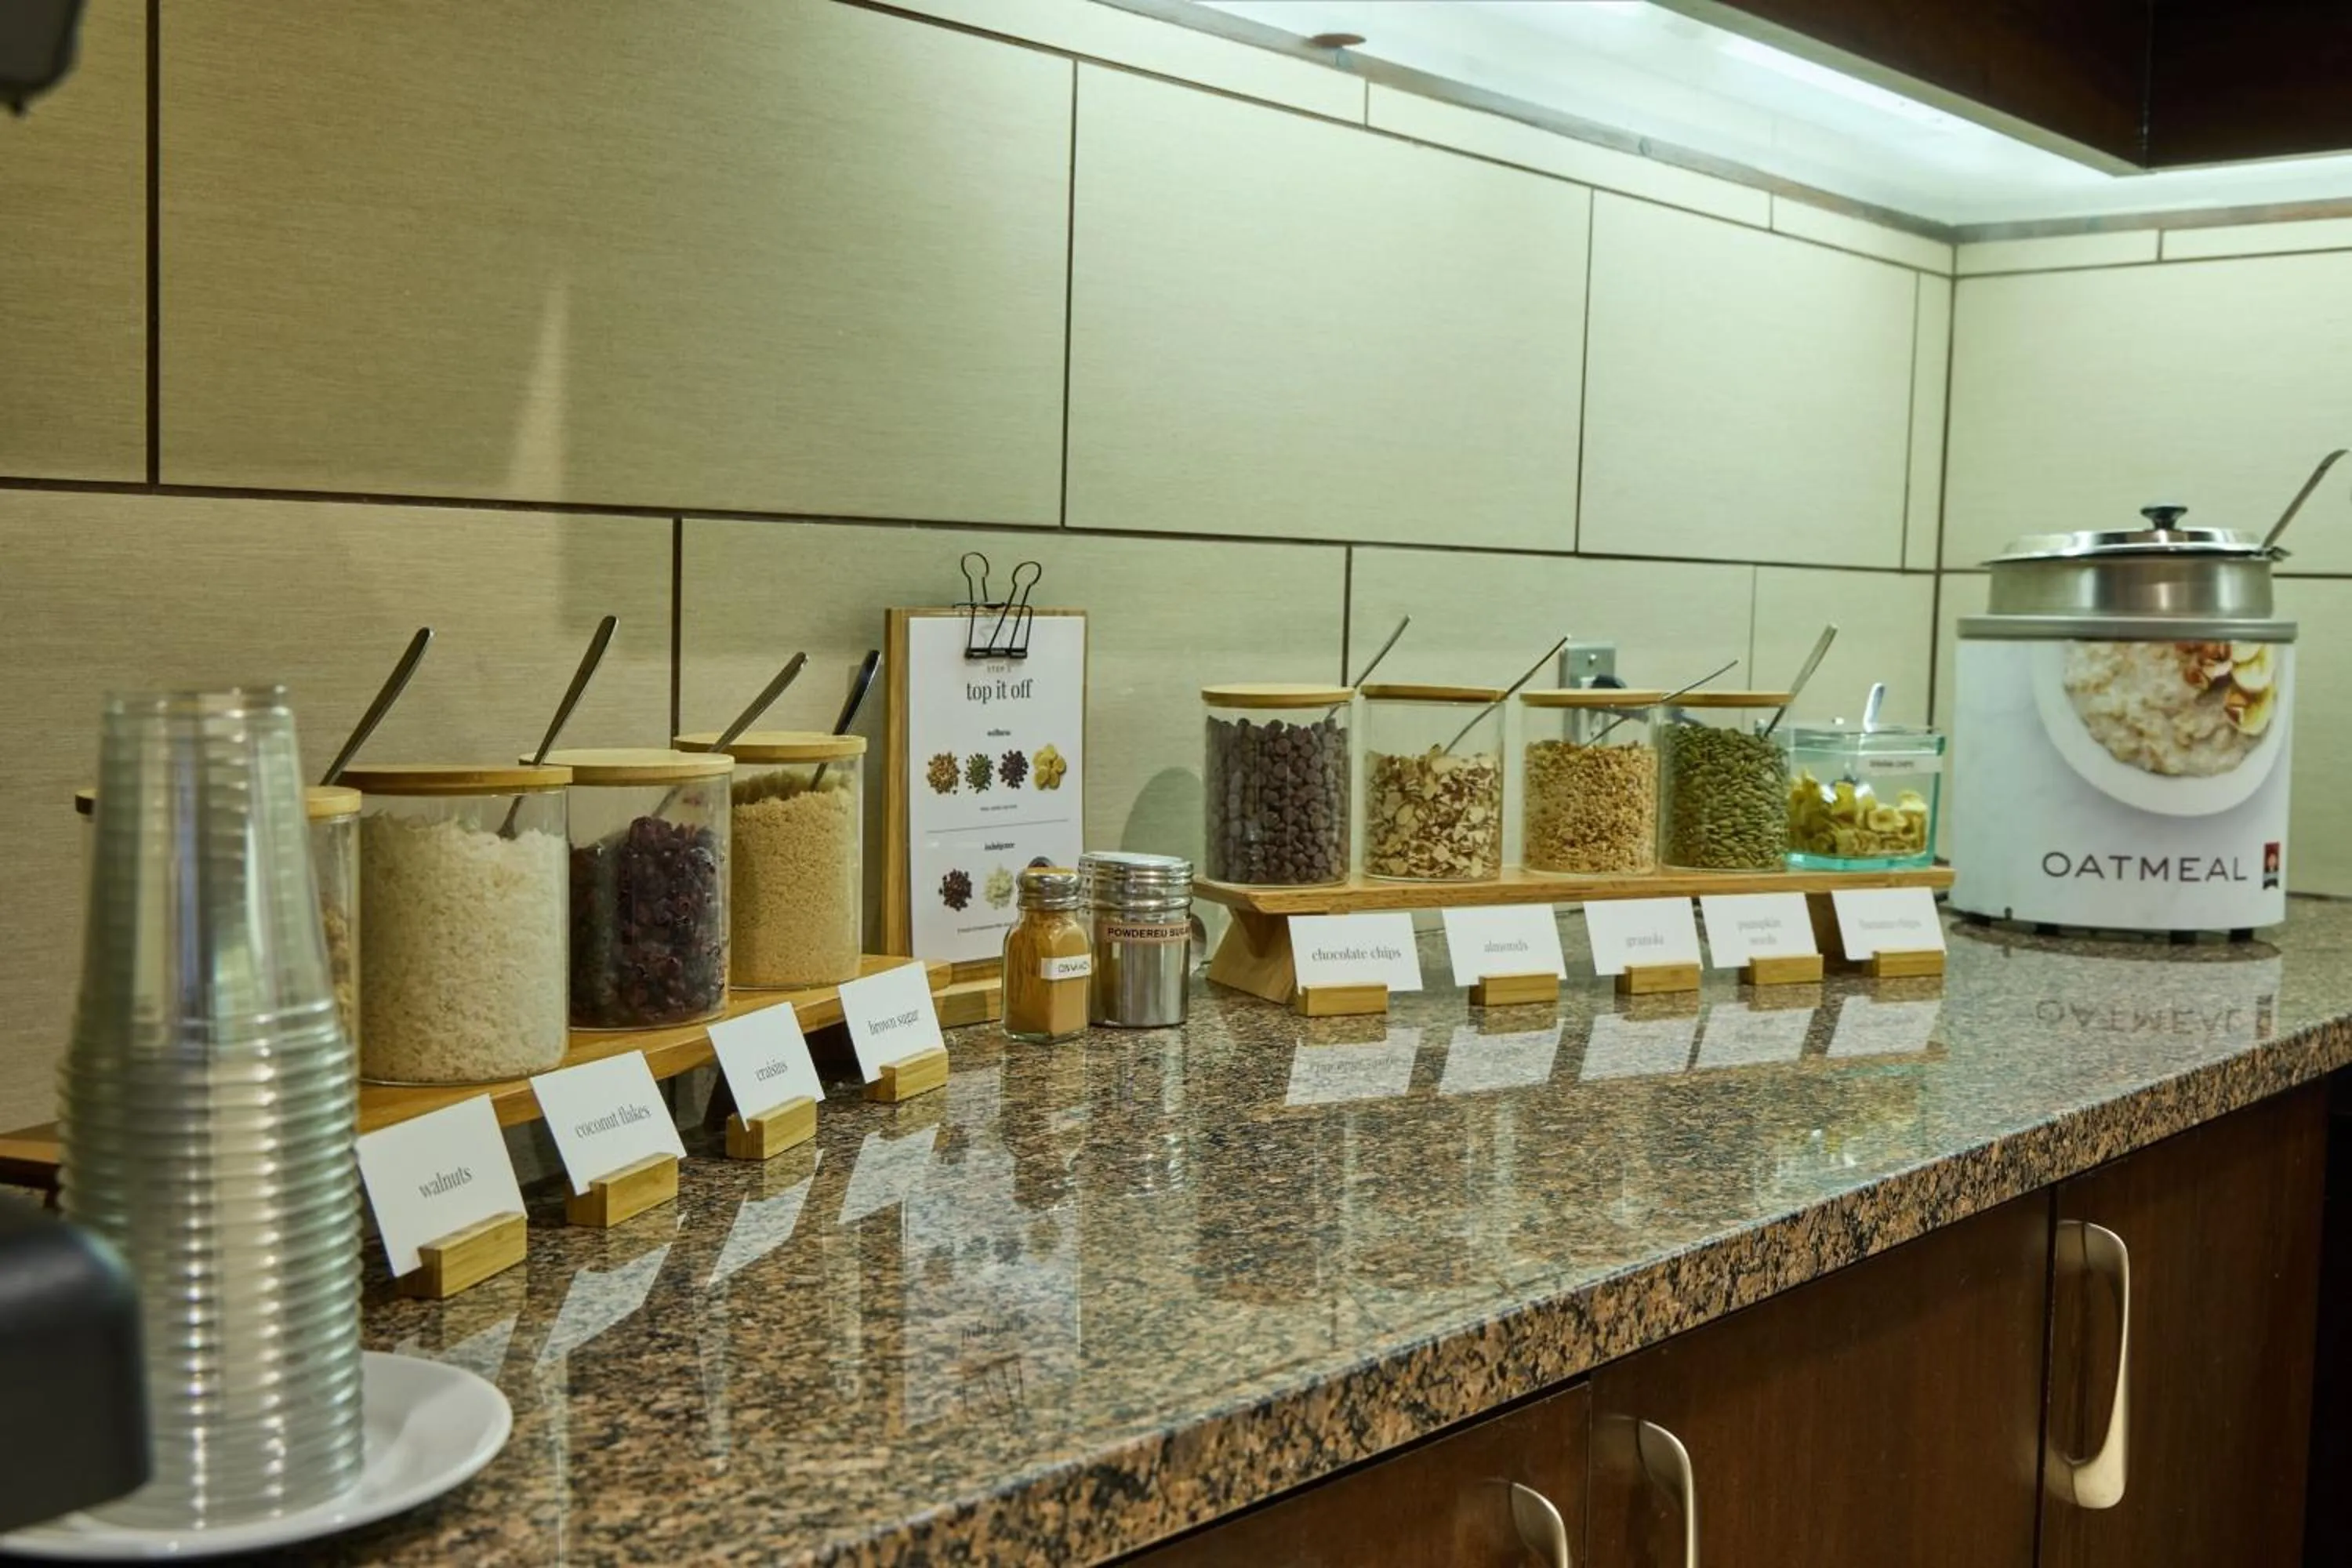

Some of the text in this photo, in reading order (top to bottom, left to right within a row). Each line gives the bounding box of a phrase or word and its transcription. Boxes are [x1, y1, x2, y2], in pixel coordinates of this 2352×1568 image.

[966, 678, 1033, 704] top it off
[2042, 851, 2248, 882] OATMEAL
[1107, 927, 1167, 938] POWDERED
[1311, 946, 1402, 962] chocolate chips
[868, 1018, 898, 1036] brown
[575, 1102, 652, 1138] coconut flakes
[418, 1166, 472, 1199] walnuts
